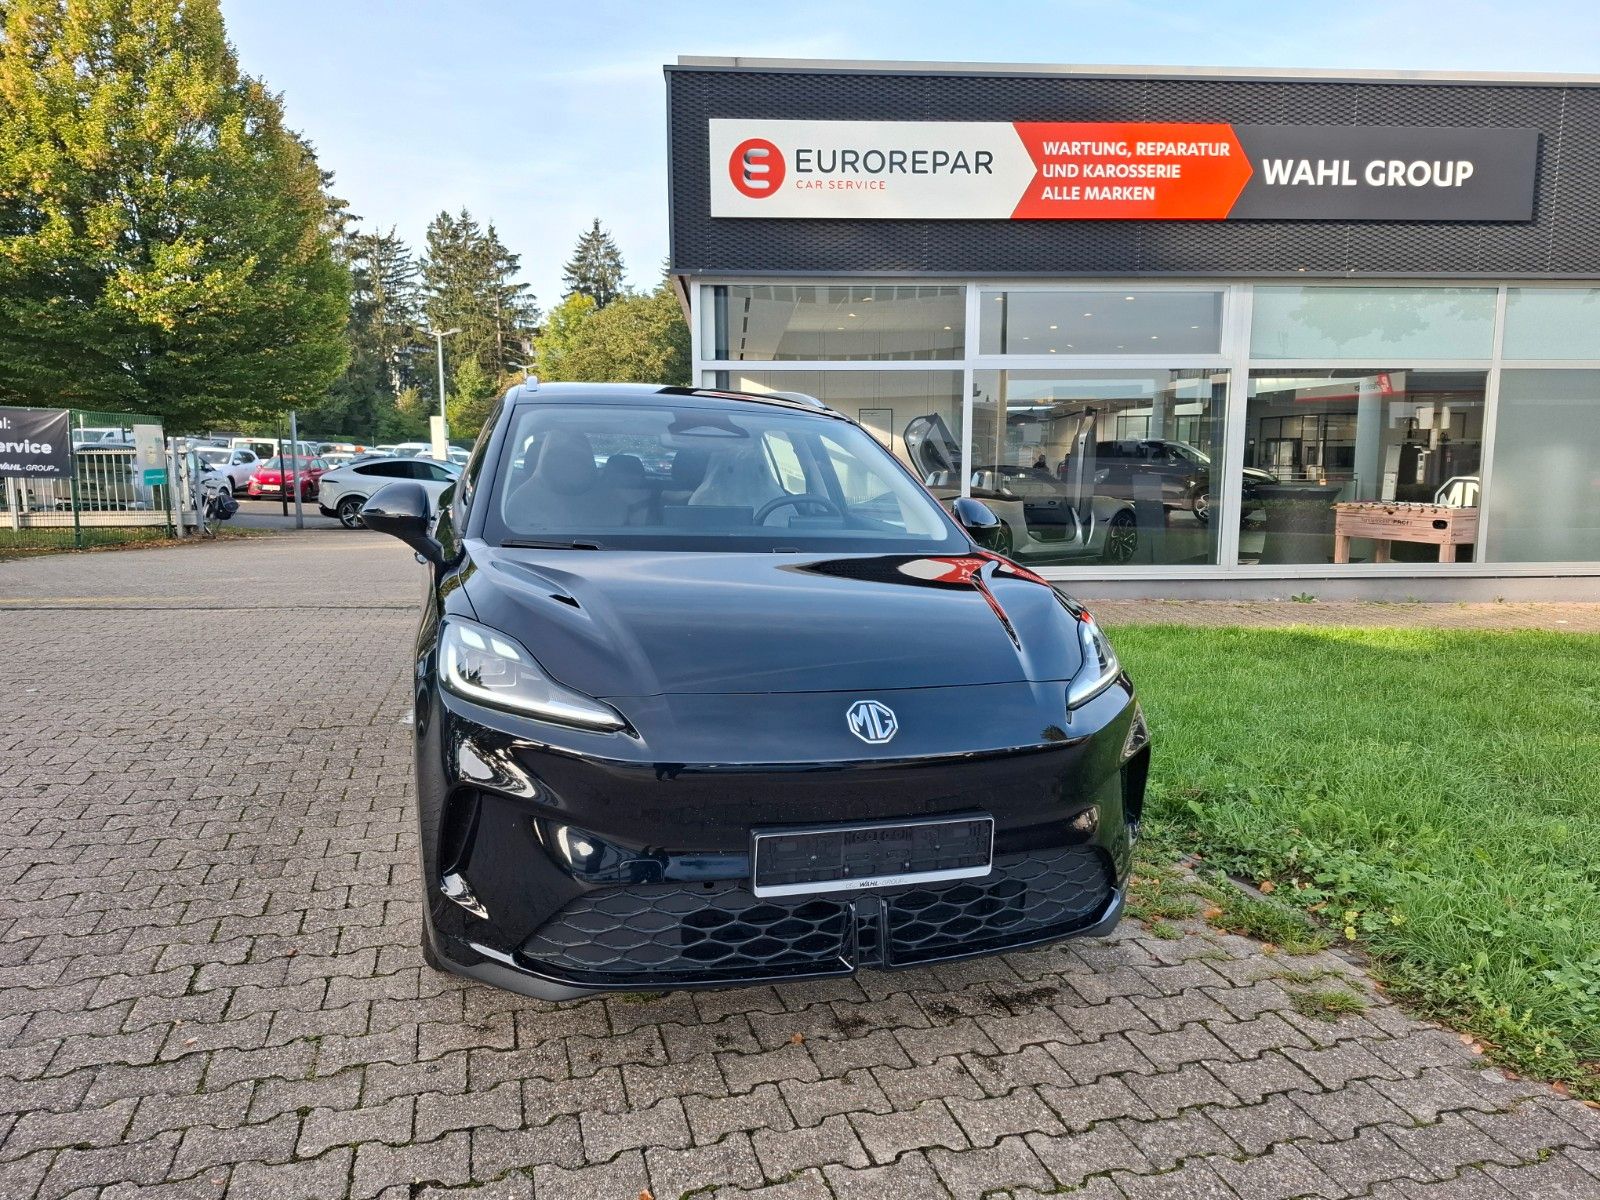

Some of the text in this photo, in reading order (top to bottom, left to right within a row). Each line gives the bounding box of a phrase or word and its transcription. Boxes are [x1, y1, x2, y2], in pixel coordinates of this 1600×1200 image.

[1042, 141, 1230, 158] WARTUNG, REPARATUR
[795, 148, 994, 174] EUROREPAR
[1042, 164, 1181, 179] UND KAROSSERIE
[1262, 159, 1474, 187] WAHL GROUP
[796, 180, 887, 190] CAR SERVICE
[1041, 186, 1156, 201] ALLE MARKEN
[850, 703, 894, 740] MG
